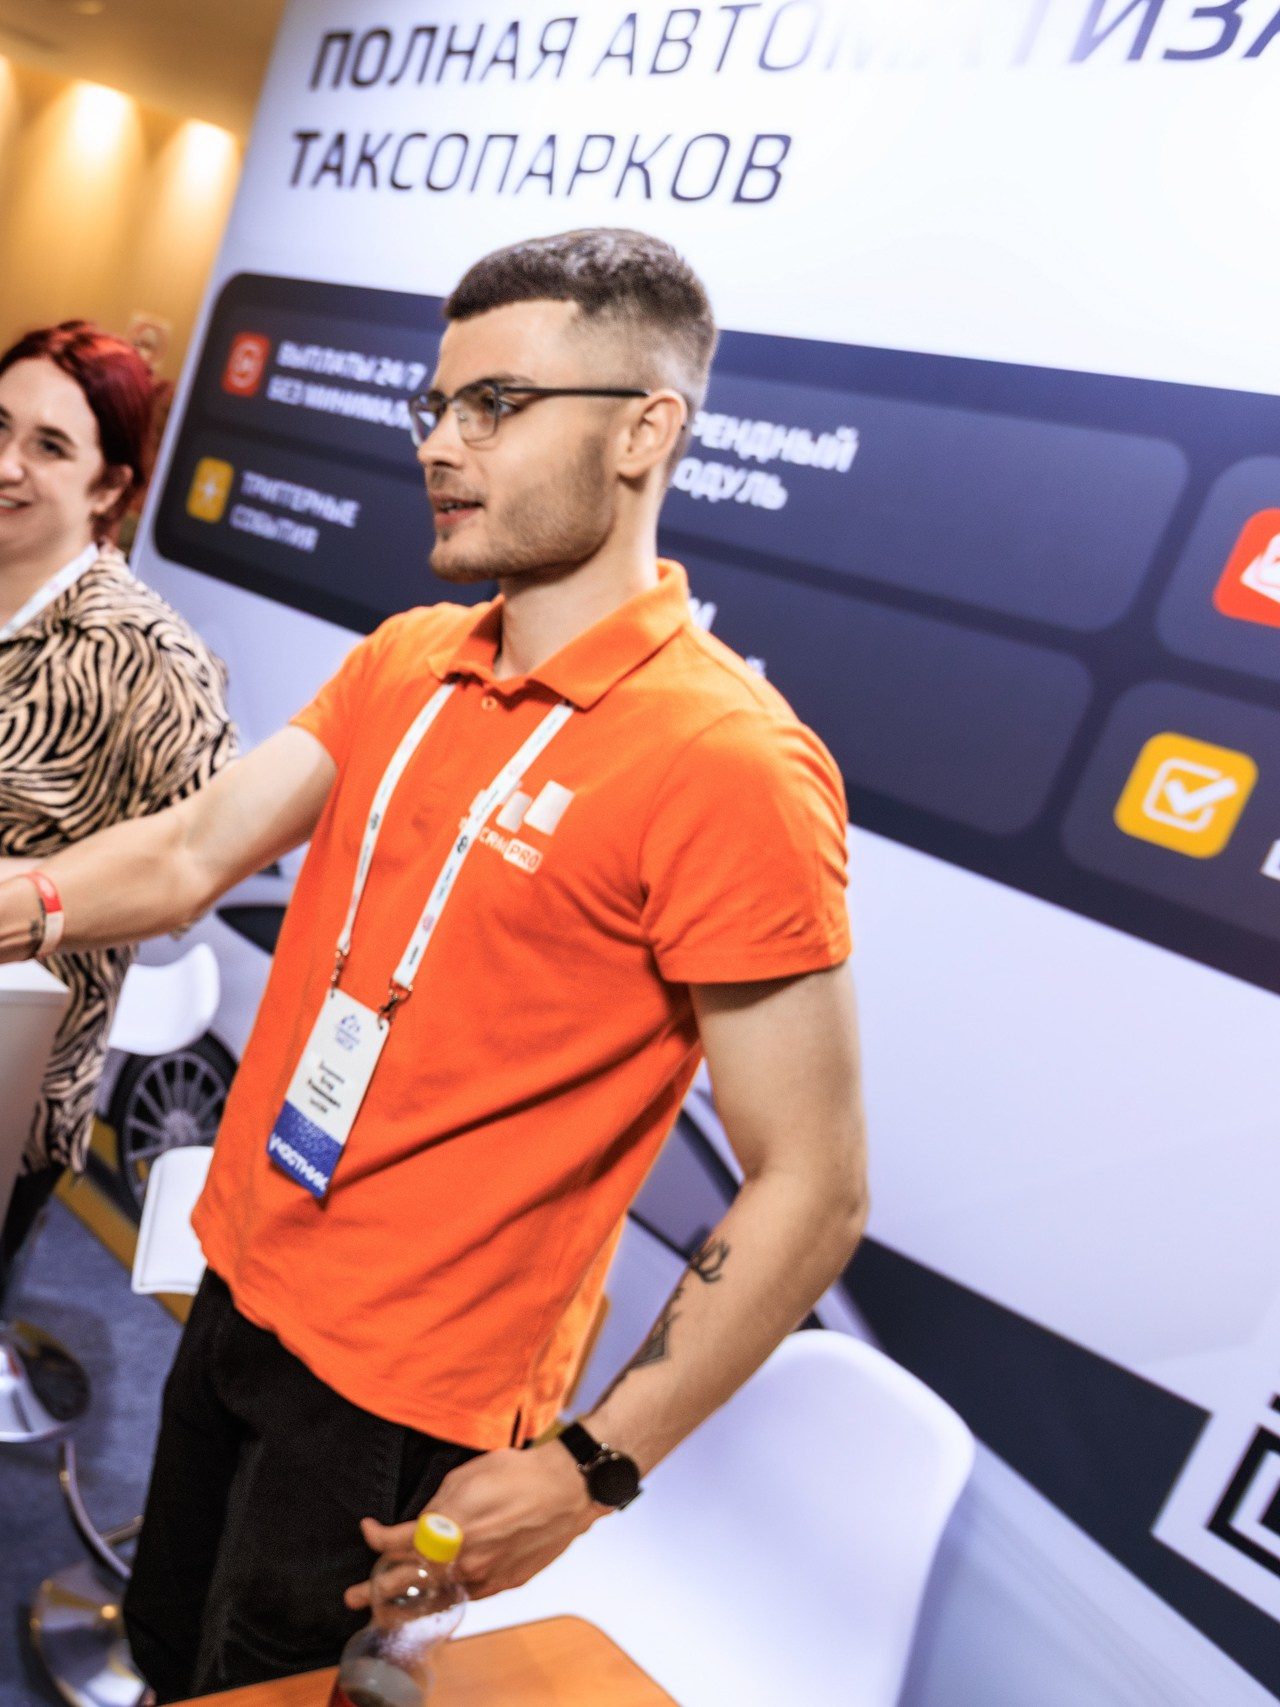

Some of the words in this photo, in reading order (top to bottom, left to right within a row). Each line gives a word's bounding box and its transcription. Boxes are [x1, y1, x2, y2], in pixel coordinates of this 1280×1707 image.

[310, 16, 579, 91] ПОЛНАЯ
[592, 0, 1280, 77] АВТОИЗ
[290, 131, 792, 204] ТАКСОПАРКОВ
[266, 374, 304, 407] БЕЗ
[304, 384, 413, 428] МИНИМАЛ
[692, 411, 859, 473] РЕНДНЫЙ
[671, 456, 788, 510] ОДУЛЬ
[507, 842, 541, 870] PRO
